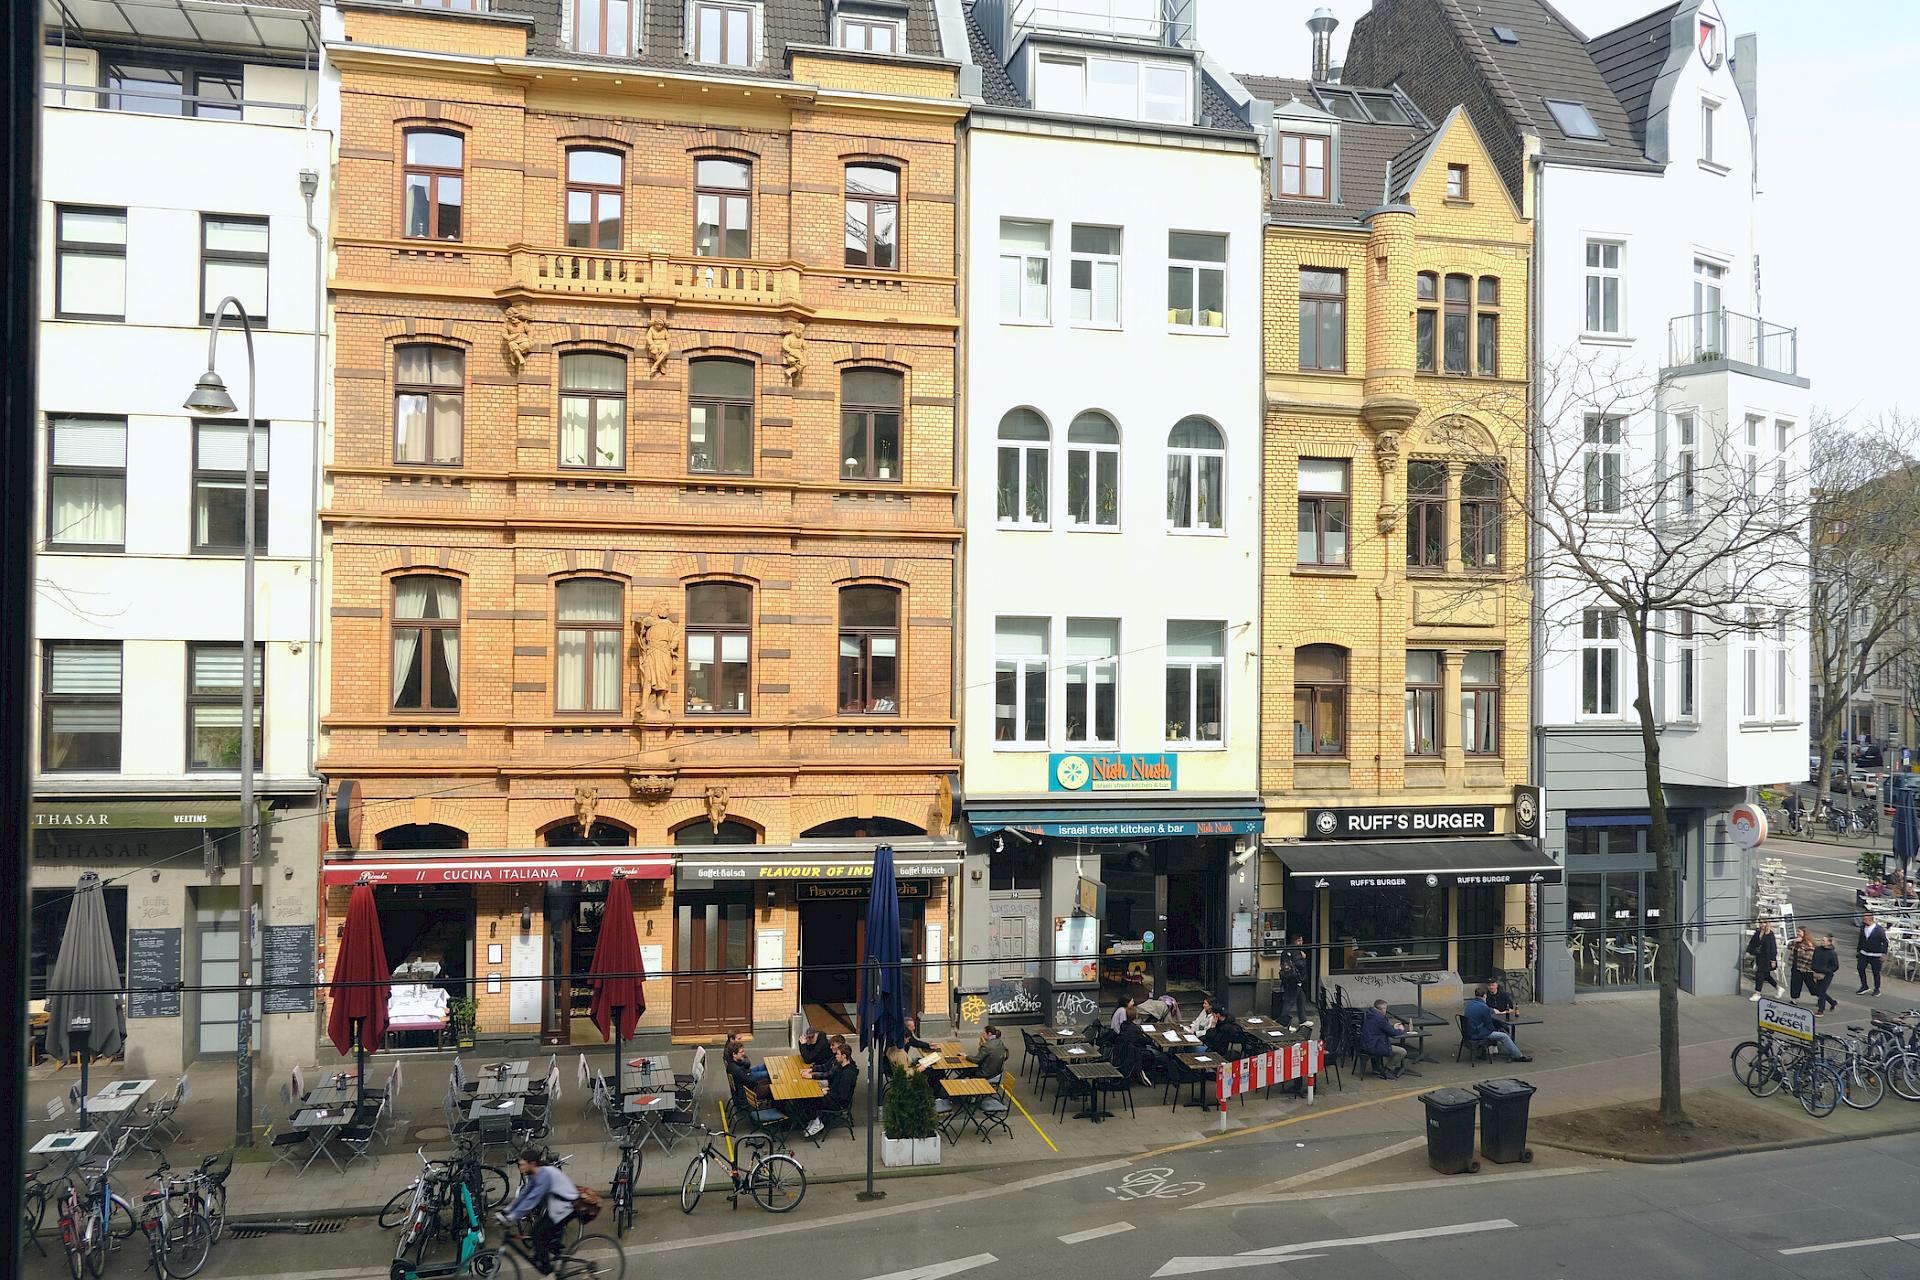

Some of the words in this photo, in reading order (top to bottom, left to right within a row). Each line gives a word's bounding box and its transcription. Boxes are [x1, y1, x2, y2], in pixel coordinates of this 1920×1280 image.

[1091, 755, 1128, 780] Nish
[1131, 754, 1172, 780] Nush
[35, 814, 109, 825] THASAR
[173, 814, 208, 823] VELTINS
[1348, 814, 1409, 831] RUFF'S
[1413, 813, 1485, 829] BURGER
[1058, 825, 1088, 835] israeli
[1090, 825, 1118, 835] street
[1120, 823, 1156, 834] kitchen
[1158, 823, 1165, 833] &
[1167, 822, 1184, 833] bar
[1197, 822, 1213, 833] Nish
[1215, 822, 1233, 833] Nush
[443, 869, 493, 881] CUCINA
[499, 868, 559, 880] ITALIANA
[759, 867, 820, 877] FLAVOUR
[826, 866, 844, 876] OF
[847, 866, 874, 876] IND
[1350, 878, 1375, 887] RUFF'S
[1376, 878, 1407, 886] BURGER
[1457, 876, 1481, 884] RUFF'S
[1482, 875, 1511, 883] BURGER
[897, 882, 918, 895] dia
[1615, 910, 1630, 919] #LIFE
[1647, 909, 1660, 917] #FRE
